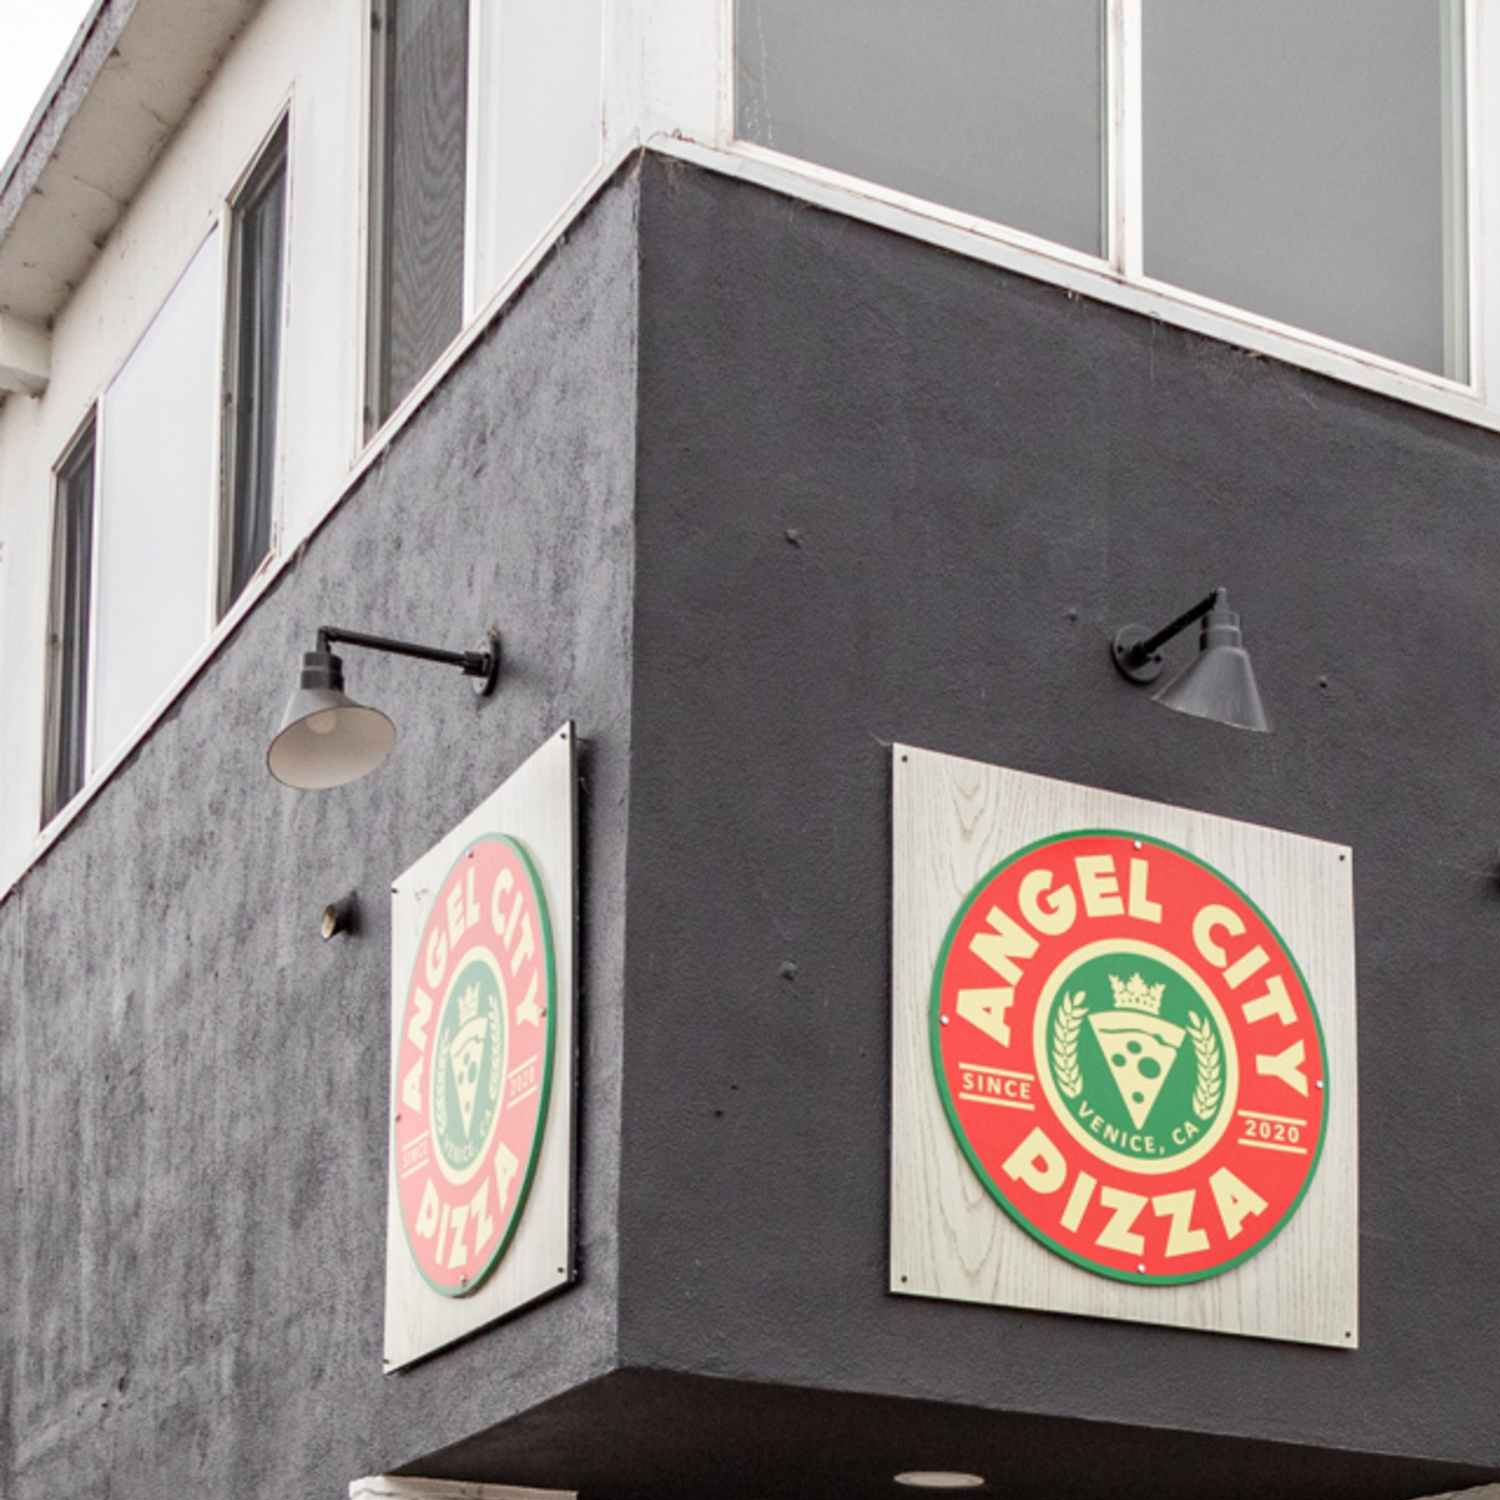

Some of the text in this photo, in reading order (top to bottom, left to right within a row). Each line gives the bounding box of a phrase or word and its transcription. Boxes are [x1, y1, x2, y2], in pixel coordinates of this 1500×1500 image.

[402, 866, 540, 1114] ANGEL CITY
[956, 855, 1309, 1097] ANGEL CITY
[963, 1073, 1031, 1100] SINCE
[1078, 1101, 1199, 1155] VENICE, CA
[1245, 1119, 1300, 1144] 2020
[402, 1138, 429, 1169] SINCE
[1002, 1126, 1269, 1258] PIZZA
[415, 1140, 520, 1270] PIZZA
